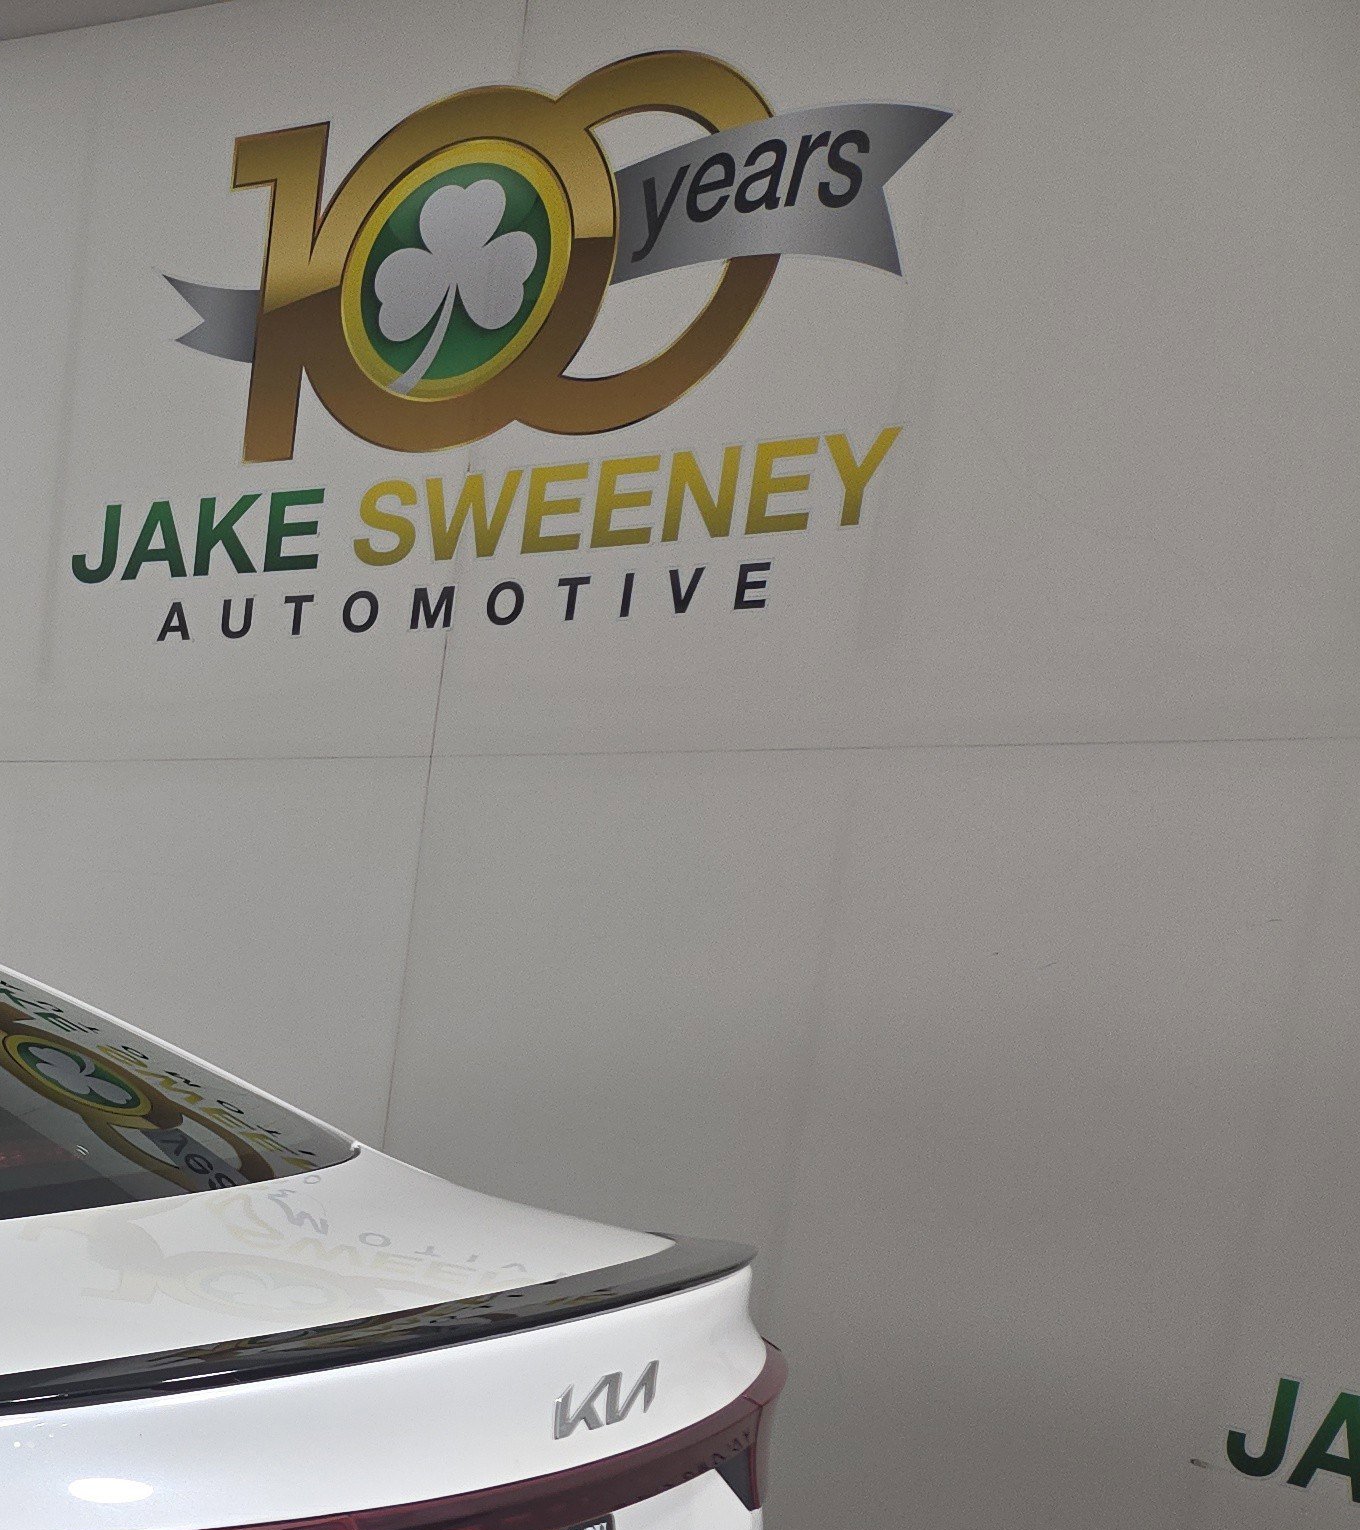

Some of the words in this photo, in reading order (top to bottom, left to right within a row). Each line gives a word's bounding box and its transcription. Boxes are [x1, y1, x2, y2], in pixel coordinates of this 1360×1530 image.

[630, 128, 872, 263] years
[71, 487, 326, 586] JAKE
[352, 425, 903, 567] SWEENEY
[157, 561, 773, 643] AUTOMOTIVE
[553, 1359, 660, 1441] KIA
